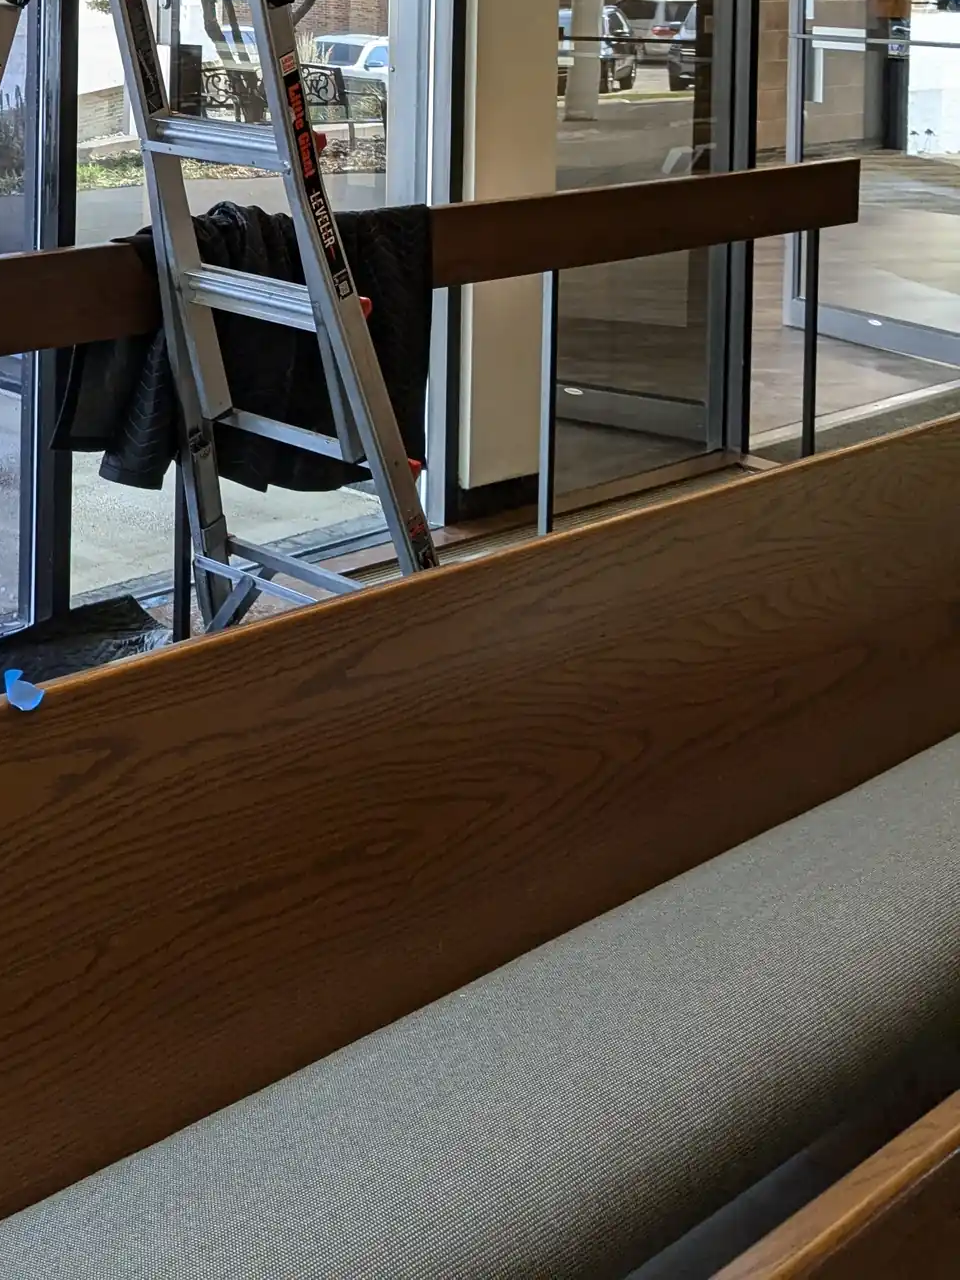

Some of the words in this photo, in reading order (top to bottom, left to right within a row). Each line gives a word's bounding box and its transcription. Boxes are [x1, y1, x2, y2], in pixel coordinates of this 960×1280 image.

[288, 83, 304, 130] Little
[298, 131, 315, 178] Giant
[310, 191, 335, 248] LEVELER
